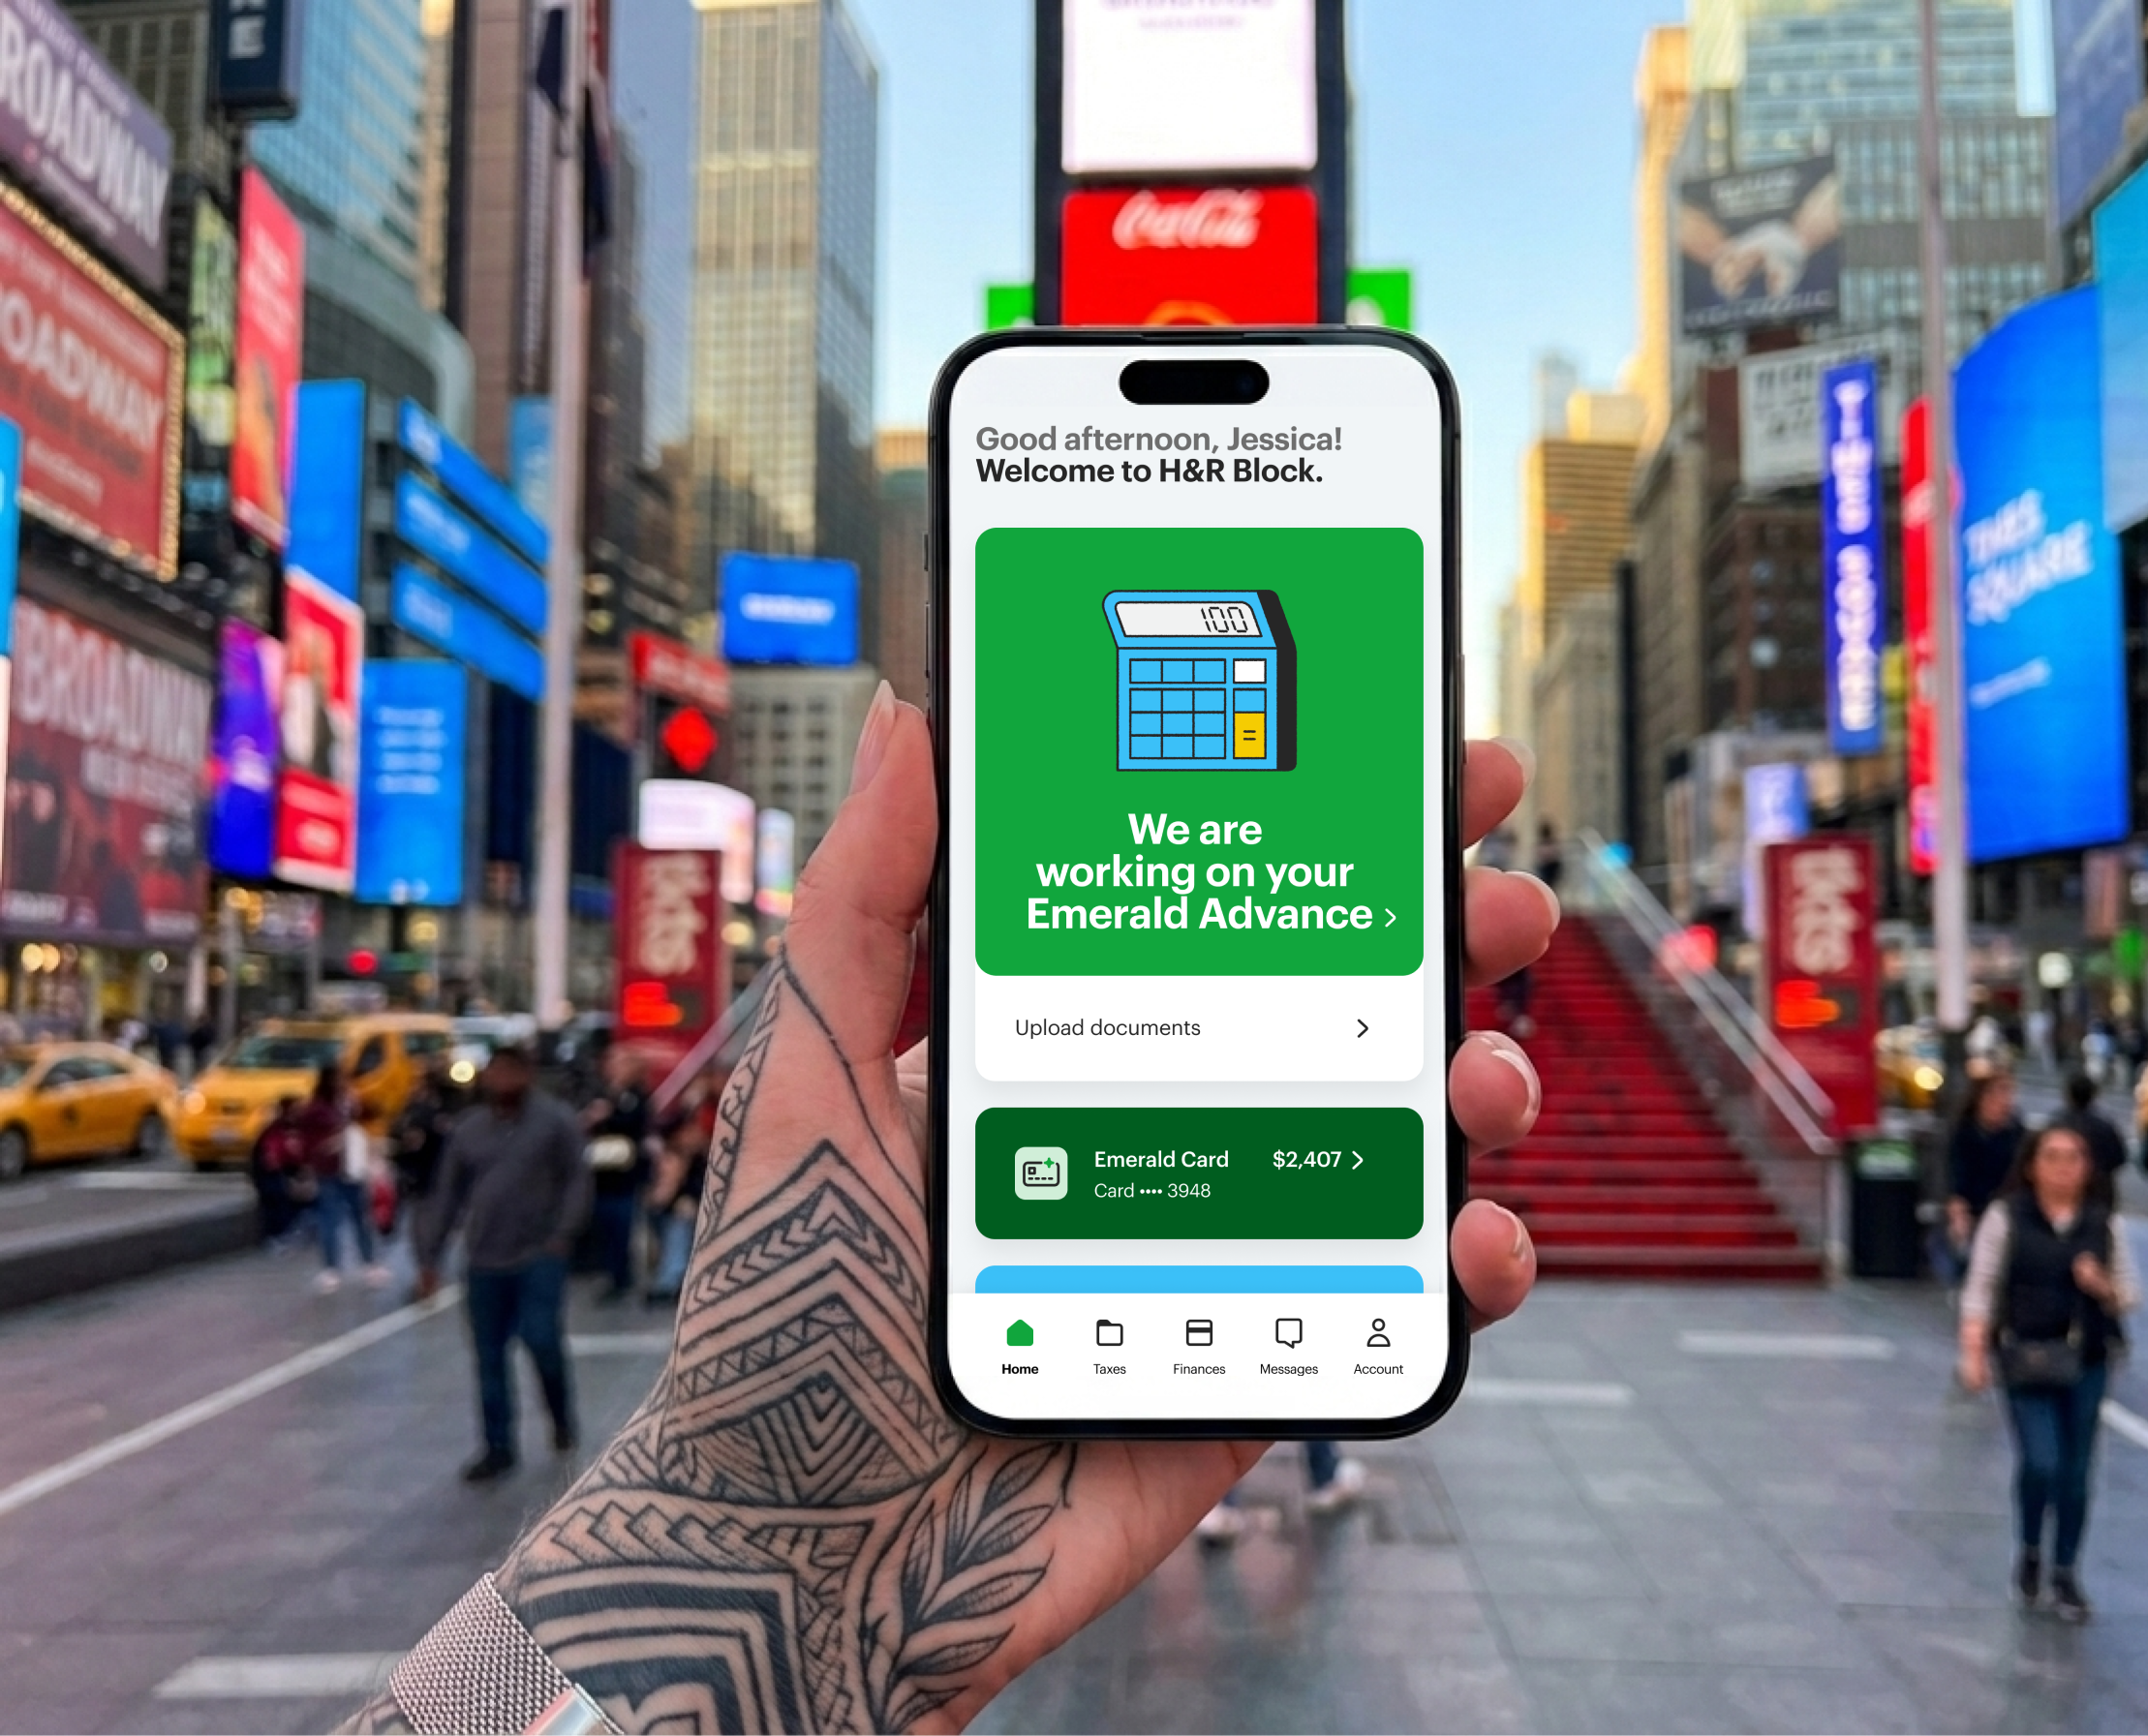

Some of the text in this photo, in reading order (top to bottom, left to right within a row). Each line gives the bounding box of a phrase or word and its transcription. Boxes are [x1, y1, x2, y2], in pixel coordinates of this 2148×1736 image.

[976, 425, 1341, 454] Good afternoon, Jessica!
[976, 457, 1323, 482] Welcome to H&R Block.
[1200, 606, 1248, 633] 100
[1128, 813, 1262, 844] We are
[1036, 854, 1354, 895] working on your
[1028, 896, 1372, 929] Emerald Advance
[1015, 1019, 1201, 1039] Upload documents
[1094, 1149, 1229, 1168] Emerald Card
[1272, 1149, 1342, 1171] $2,407
[1094, 1182, 1135, 1199] Card
[1167, 1182, 1212, 1199] 3948
[1001, 1363, 1039, 1375] Home
[1093, 1363, 1126, 1375] Taxes
[1173, 1362, 1226, 1375] Finances
[1260, 1363, 1319, 1377] Messages
[1354, 1363, 1404, 1375] Account
